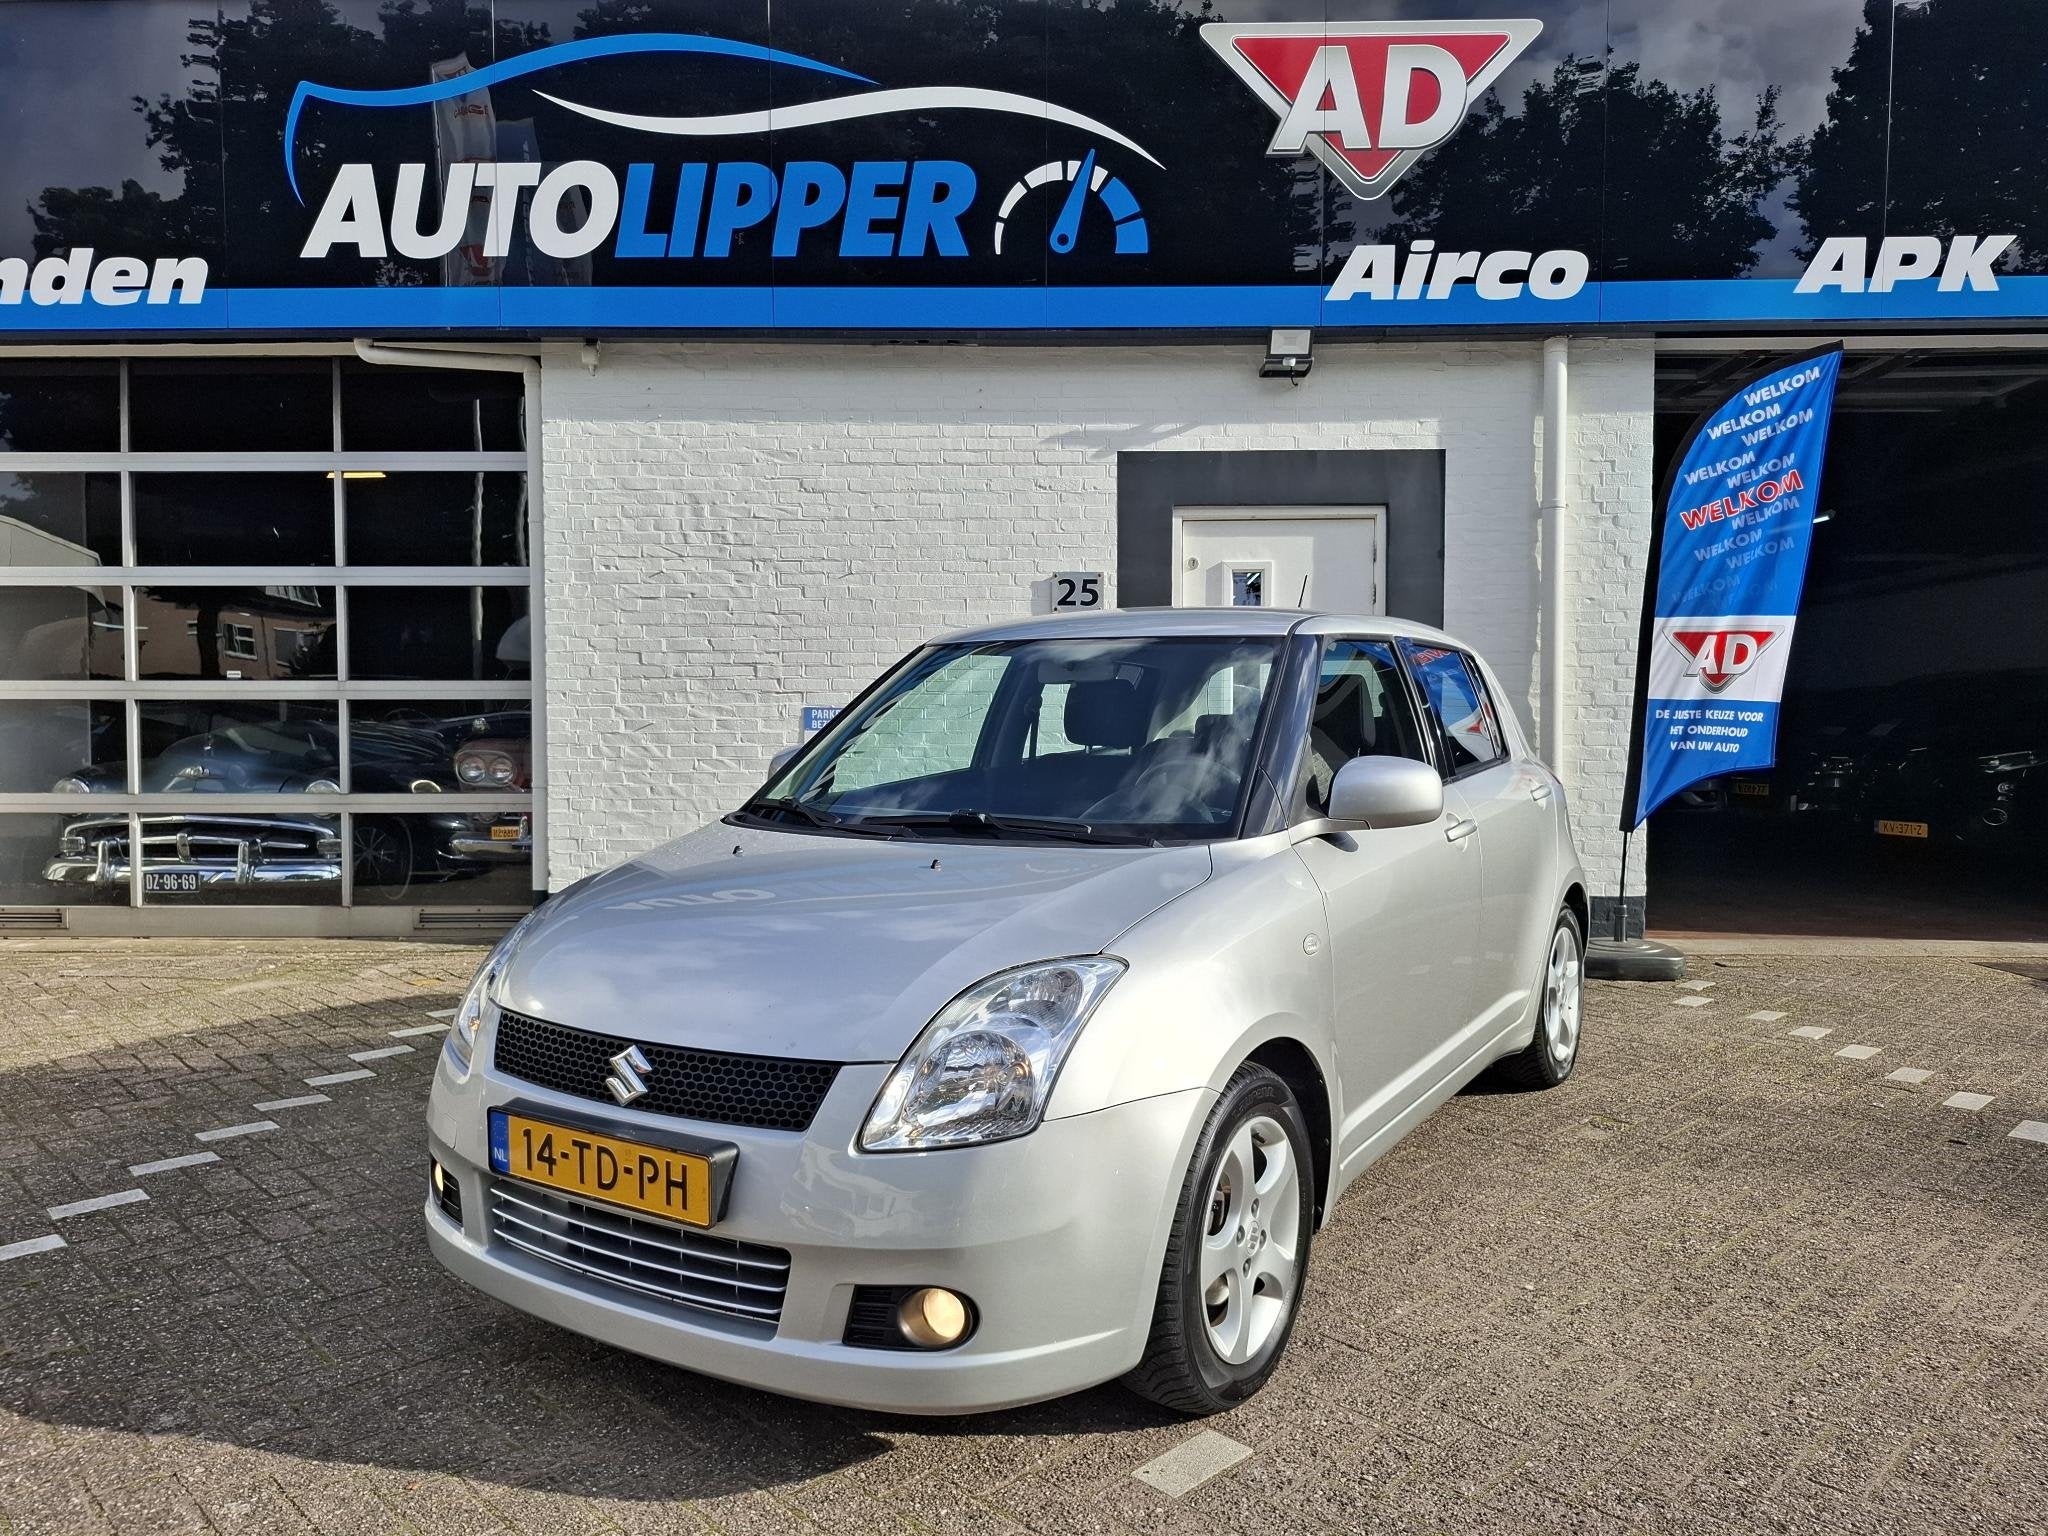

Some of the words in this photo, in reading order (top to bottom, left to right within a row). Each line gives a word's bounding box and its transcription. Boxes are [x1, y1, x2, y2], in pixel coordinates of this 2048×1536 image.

[1272, 44, 1468, 150] AD
[299, 160, 977, 259] AUTOLIPPER
[1325, 239, 1589, 301] Airco
[1795, 234, 2018, 294] APK
[1743, 366, 1821, 407] WELKOM
[1706, 402, 1782, 440] WELKOM
[1740, 407, 1814, 447] WELKOM
[1684, 450, 1756, 486] WELKOM
[1726, 452, 1796, 489] WELKOM
[1679, 468, 1804, 531] WELKOM
[1731, 495, 1800, 531] WELKOM
[1693, 528, 1763, 563] WELKOM
[1725, 536, 1796, 569] WELKOM
[1057, 578, 1099, 607] 25
[1685, 633, 1759, 677] AD
[1655, 709, 1670, 719] DE
[1705, 709, 1735, 721] KEUZE
[1737, 711, 1764, 722] VOOR
[1687, 725, 1749, 738] ONDERHOUD
[1670, 740, 1696, 751] VAN
[1698, 741, 1714, 751] UW
[1714, 742, 1740, 753] AUTO
[145, 873, 197, 890] DZ-96-69
[494, 1146, 508, 1162] NL
[522, 1128, 688, 1211] 14-TD-PH
